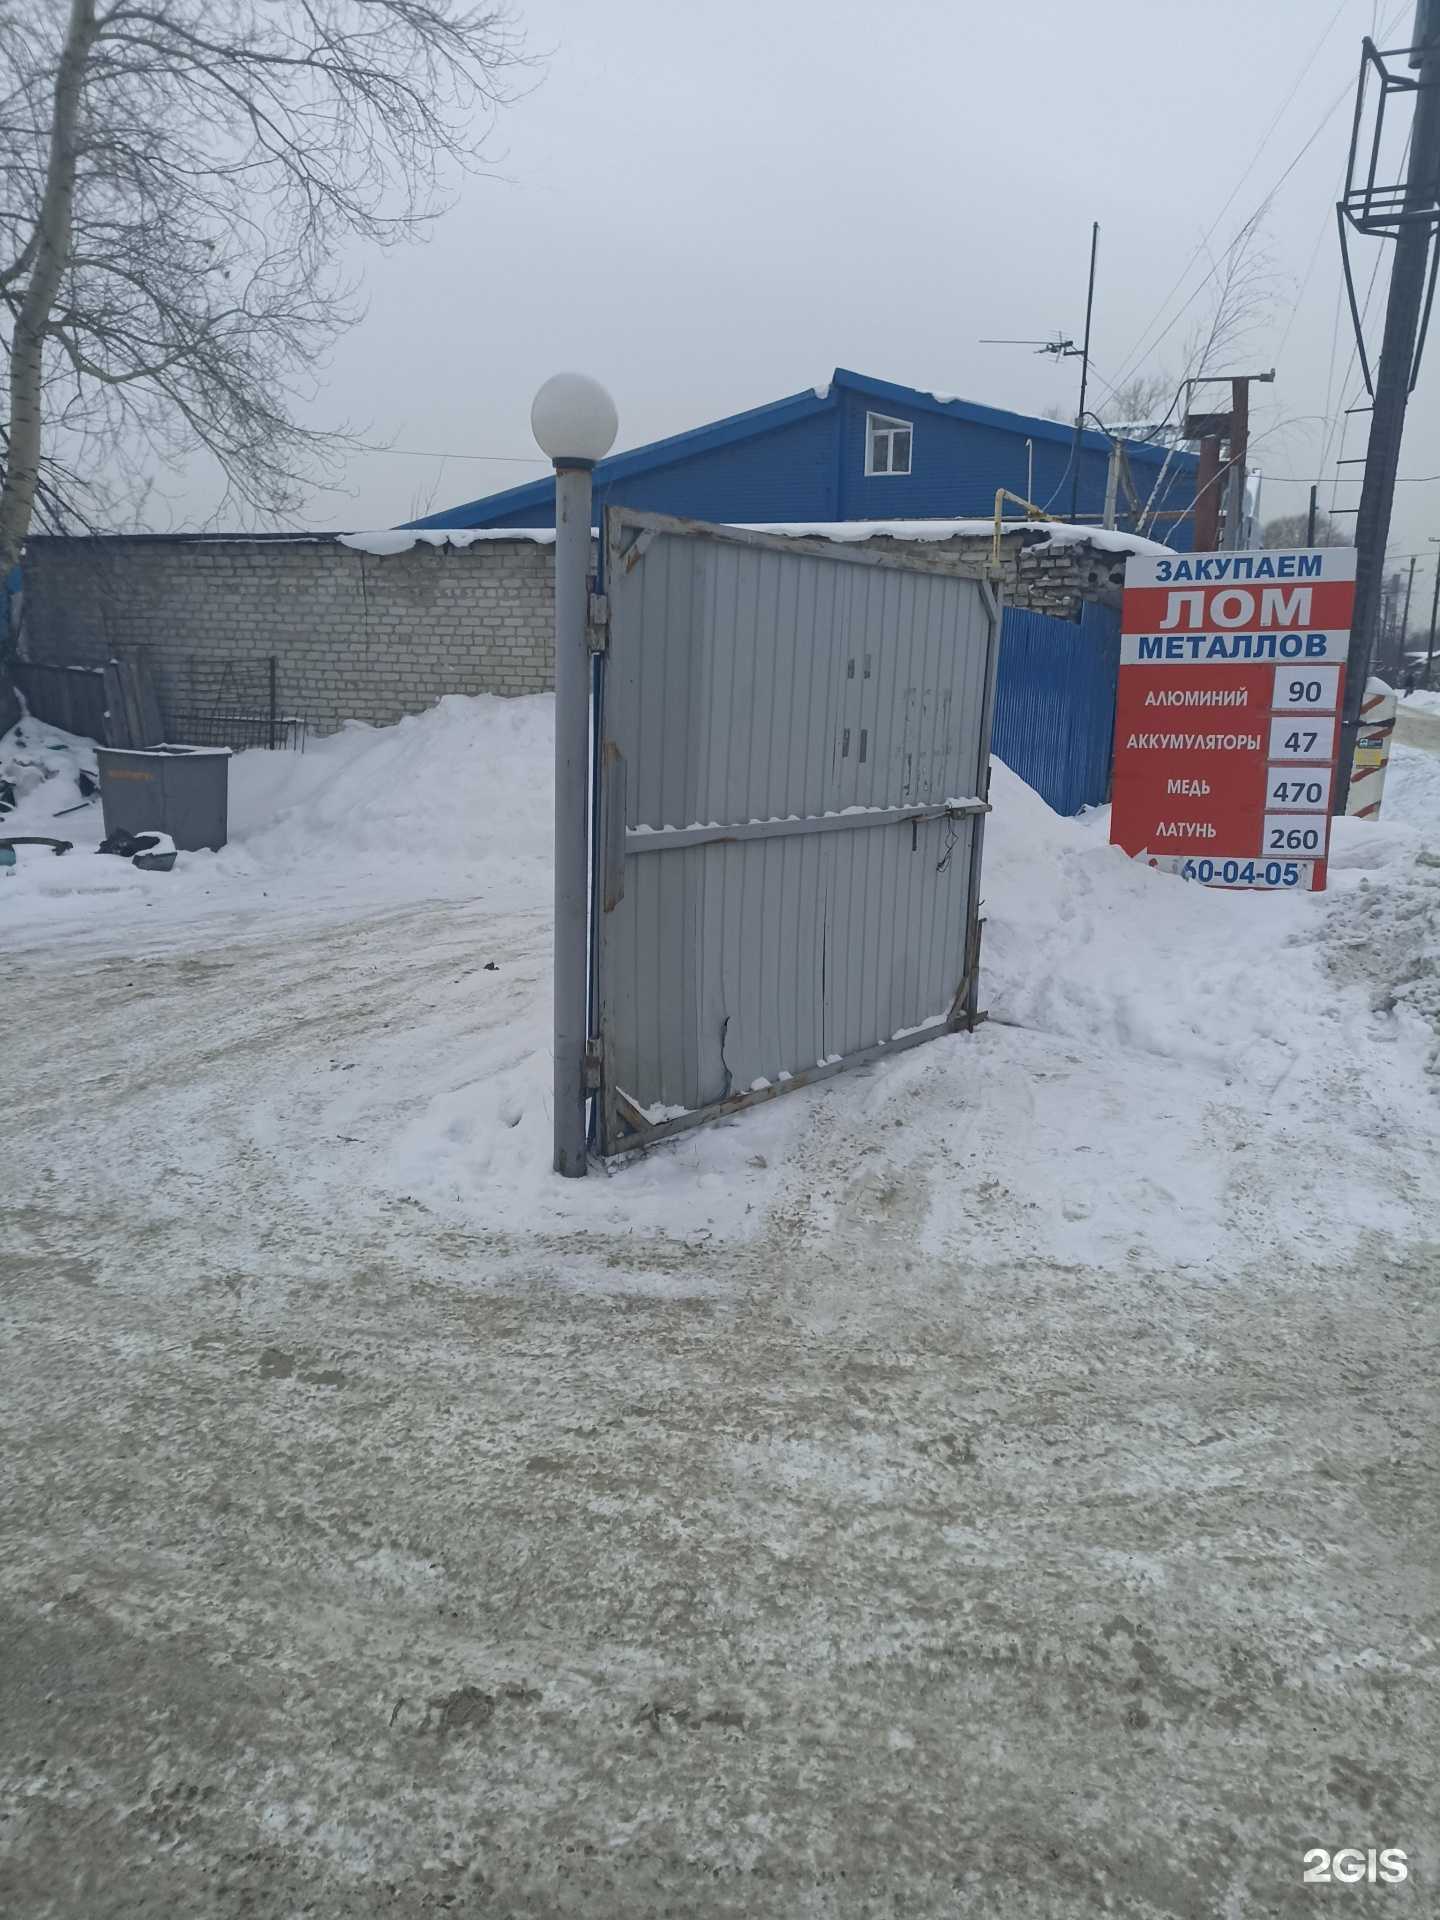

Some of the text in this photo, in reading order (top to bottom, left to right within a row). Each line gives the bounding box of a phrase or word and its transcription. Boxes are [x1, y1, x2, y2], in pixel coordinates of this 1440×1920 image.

[1155, 555, 1323, 582] ЗАКУПАЕМ
[1159, 587, 1313, 629] ЛОМ
[1138, 633, 1328, 659] МЕТАЛЛОВ
[1144, 681, 1322, 707] АЛЮМИНИЙ 90
[1126, 731, 1319, 754] АККУМУЛЯТОРЫ 47
[1167, 778, 1323, 803] МЕДЬ 470
[1155, 822, 1319, 850] ЛАТУНЬ 260
